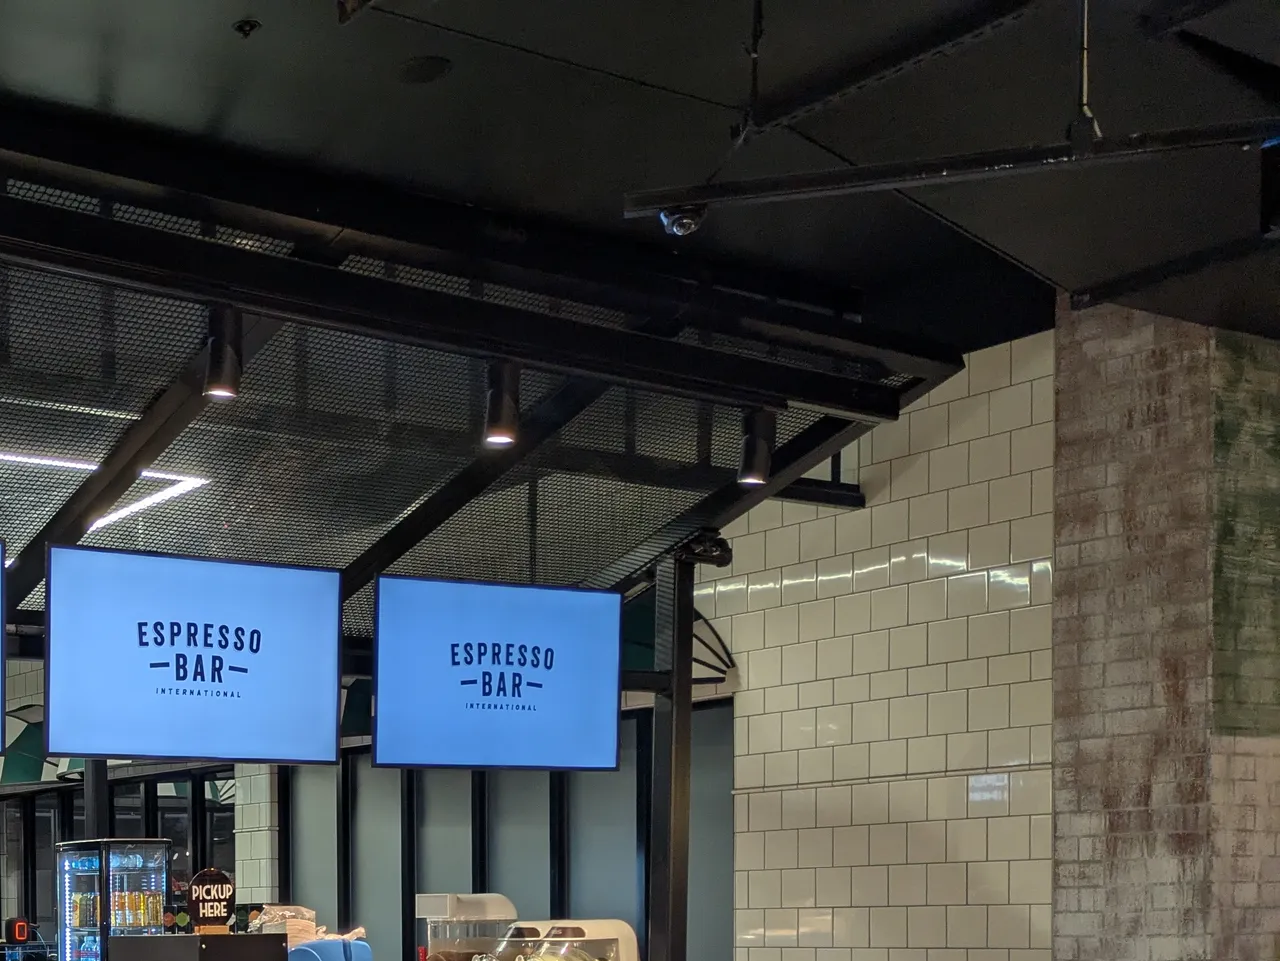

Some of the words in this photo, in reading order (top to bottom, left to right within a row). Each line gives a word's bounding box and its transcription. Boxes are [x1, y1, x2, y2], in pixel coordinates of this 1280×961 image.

[137, 621, 261, 653] ESPRESSO
[450, 642, 554, 670] ESPRESSO
[175, 653, 224, 683] BAR
[156, 687, 241, 698] INTERNATIONAL
[482, 671, 522, 698] BAR
[465, 702, 537, 711] INTERNATIONAL
[192, 884, 233, 901] PICKUP
[199, 902, 228, 917] HERE
